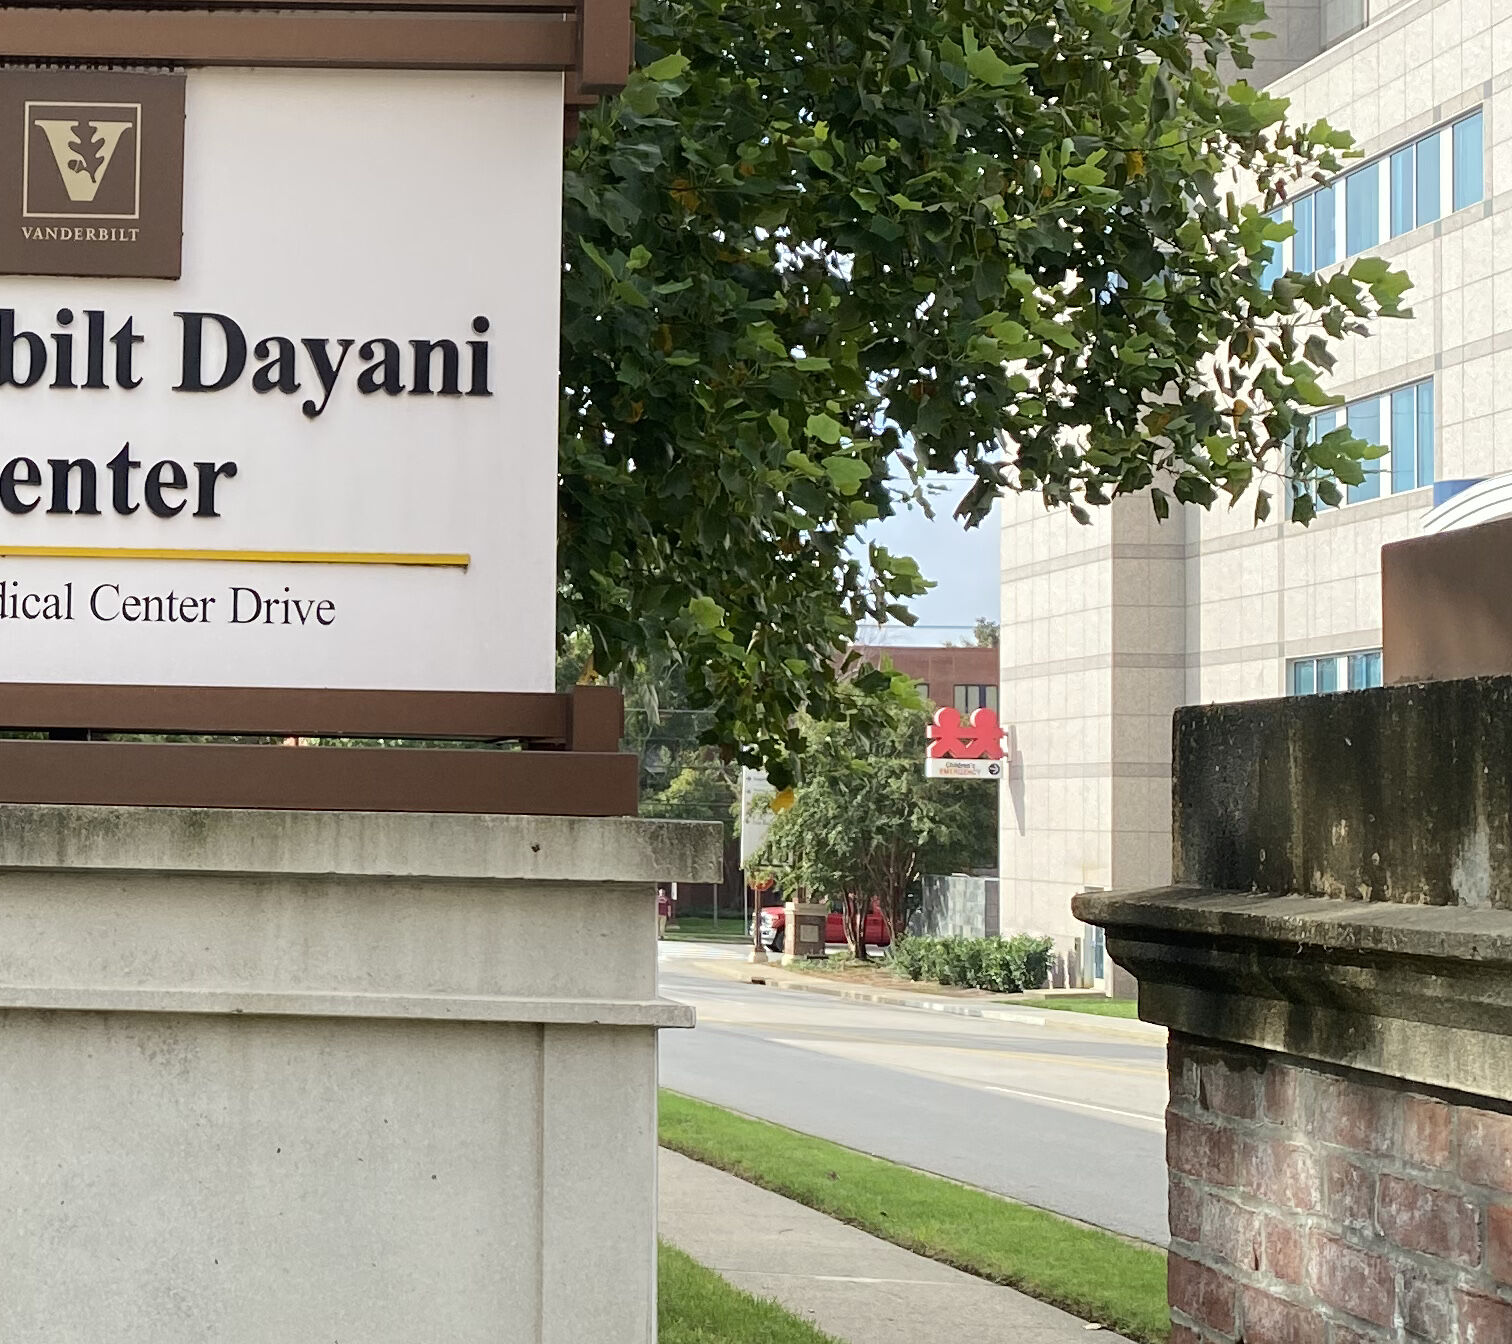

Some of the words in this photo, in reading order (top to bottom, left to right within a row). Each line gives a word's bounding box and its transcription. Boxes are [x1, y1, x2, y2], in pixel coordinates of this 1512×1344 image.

[34, 119, 133, 202] V
[21, 226, 140, 242] VANDERBILT
[171, 311, 494, 420] Dayani
[89, 583, 217, 624] Center
[229, 586, 337, 627] Drive
